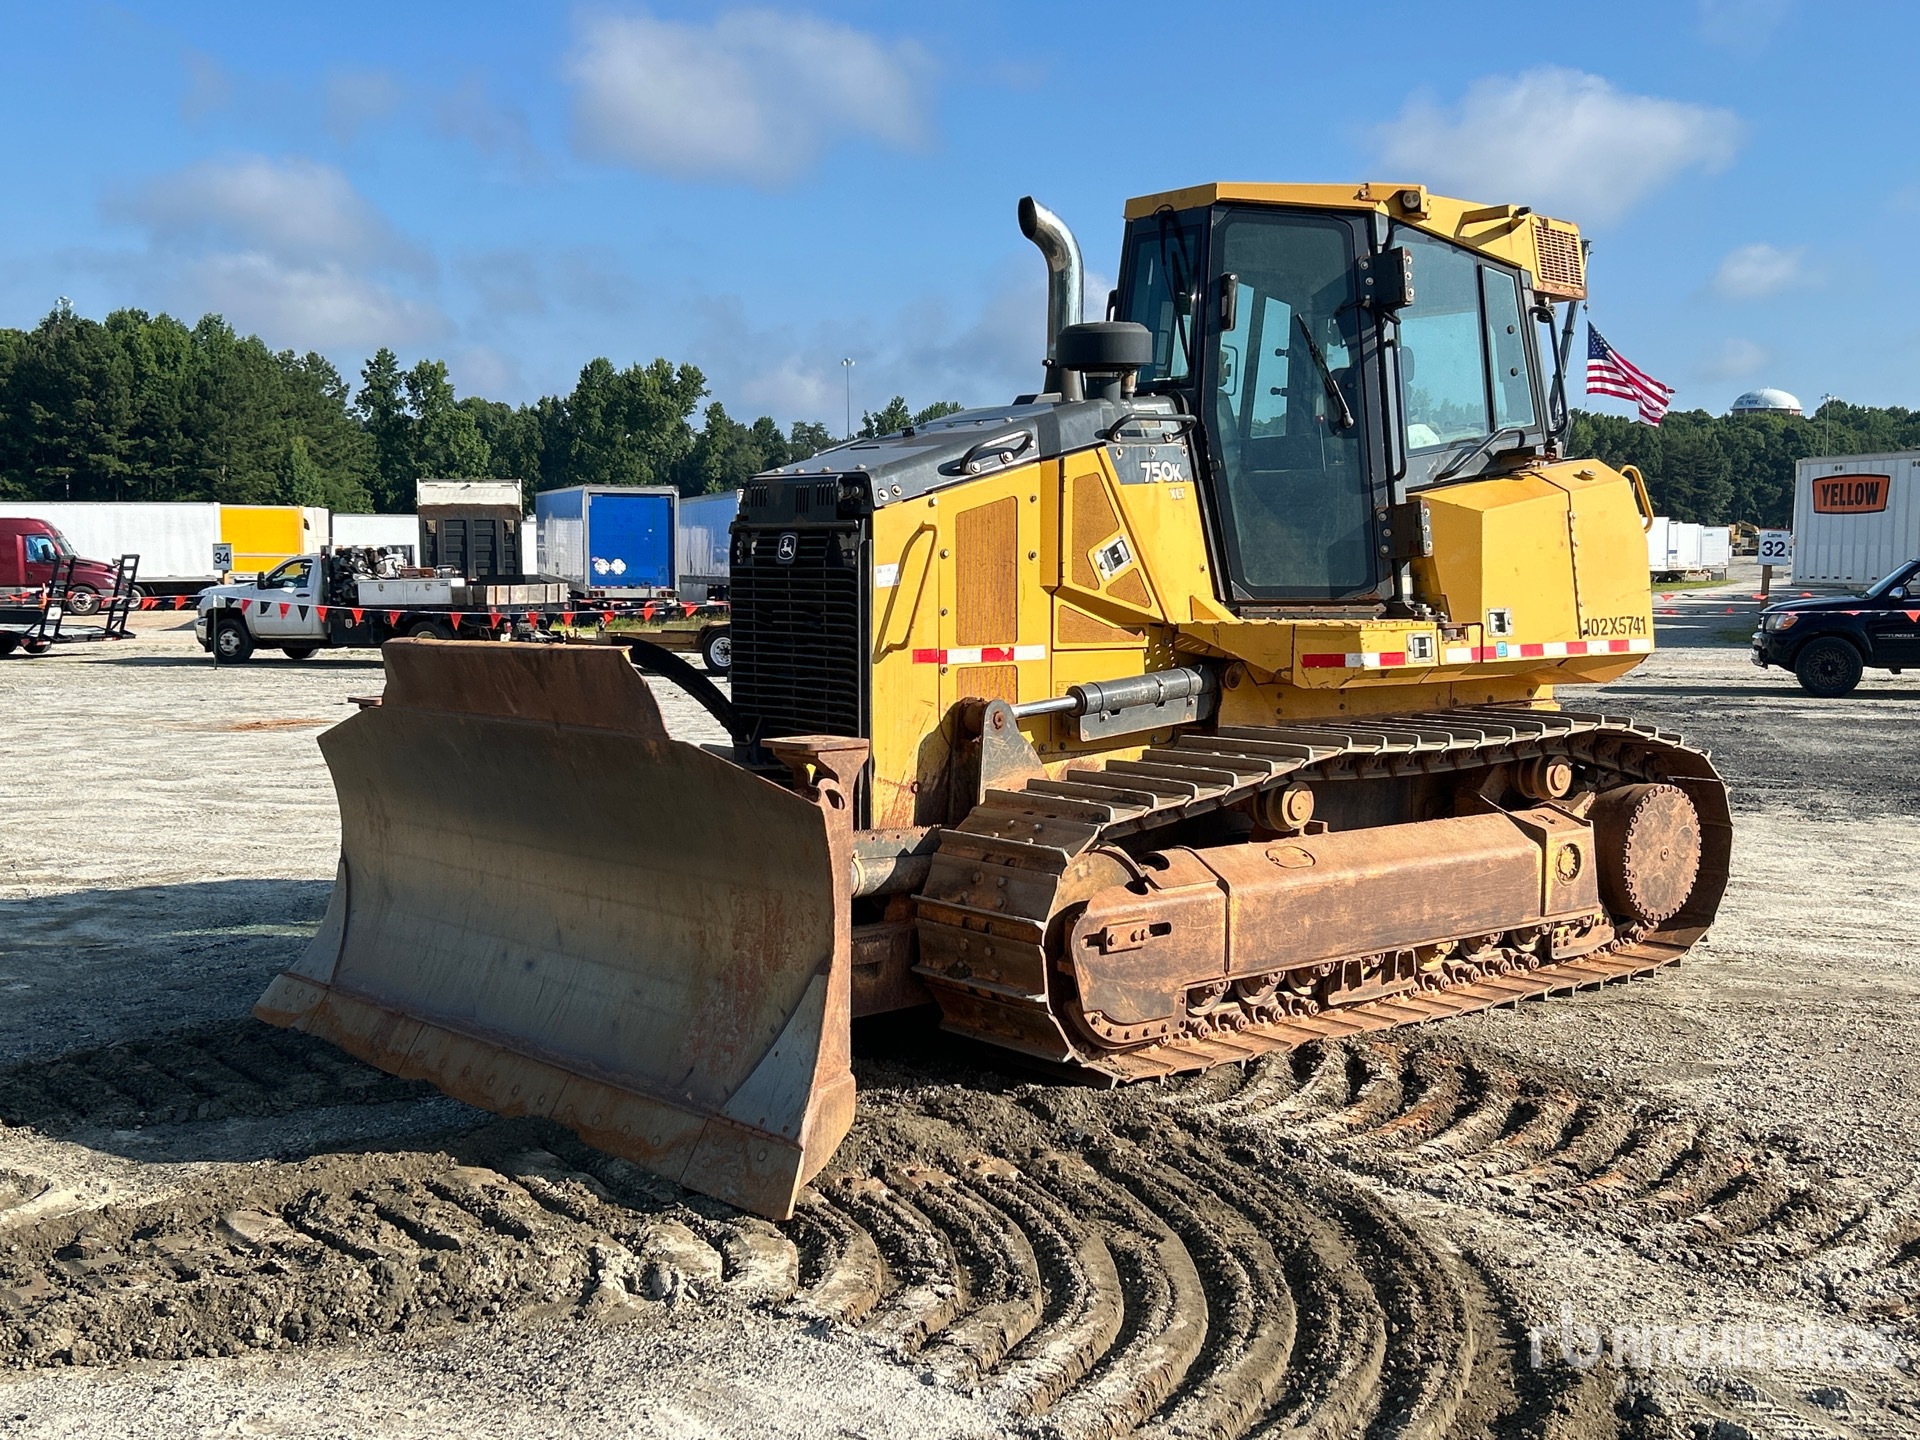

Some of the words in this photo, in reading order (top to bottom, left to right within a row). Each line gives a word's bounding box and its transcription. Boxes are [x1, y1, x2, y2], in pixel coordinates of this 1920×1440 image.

[1140, 461, 1184, 483] 750K
[1168, 487, 1185, 500] XLT
[1821, 482, 1880, 506] YELLOW
[1762, 541, 1785, 557] 32
[215, 552, 230, 564] 34
